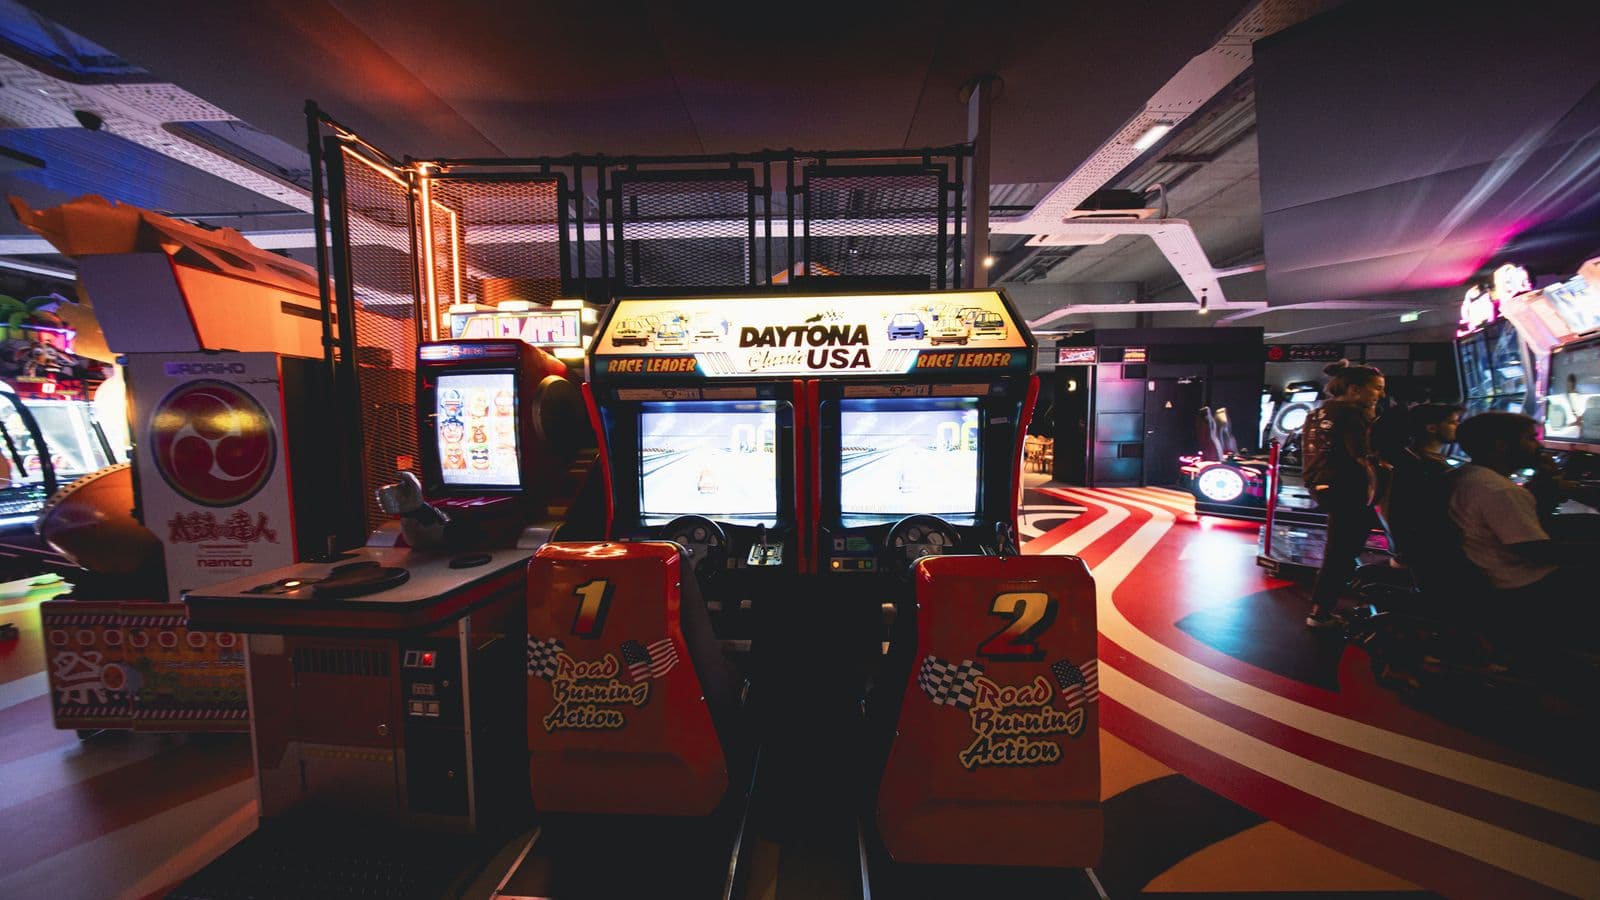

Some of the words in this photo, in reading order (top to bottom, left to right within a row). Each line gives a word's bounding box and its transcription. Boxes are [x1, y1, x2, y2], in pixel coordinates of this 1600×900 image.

[739, 324, 869, 347] DAYTONA
[608, 358, 642, 373] RACE
[646, 357, 697, 372] LEADER
[807, 348, 871, 369] USA
[916, 353, 953, 368] RACE
[957, 352, 1012, 367] LEADER
[197, 559, 253, 567] namco
[573, 578, 613, 637] 1
[978, 590, 1054, 658] 2
[555, 653, 619, 681] Road
[553, 679, 649, 705] Burning
[974, 675, 1052, 708] Road
[544, 703, 624, 729] Action
[969, 706, 1084, 735] Burning
[959, 734, 1060, 768] Action
